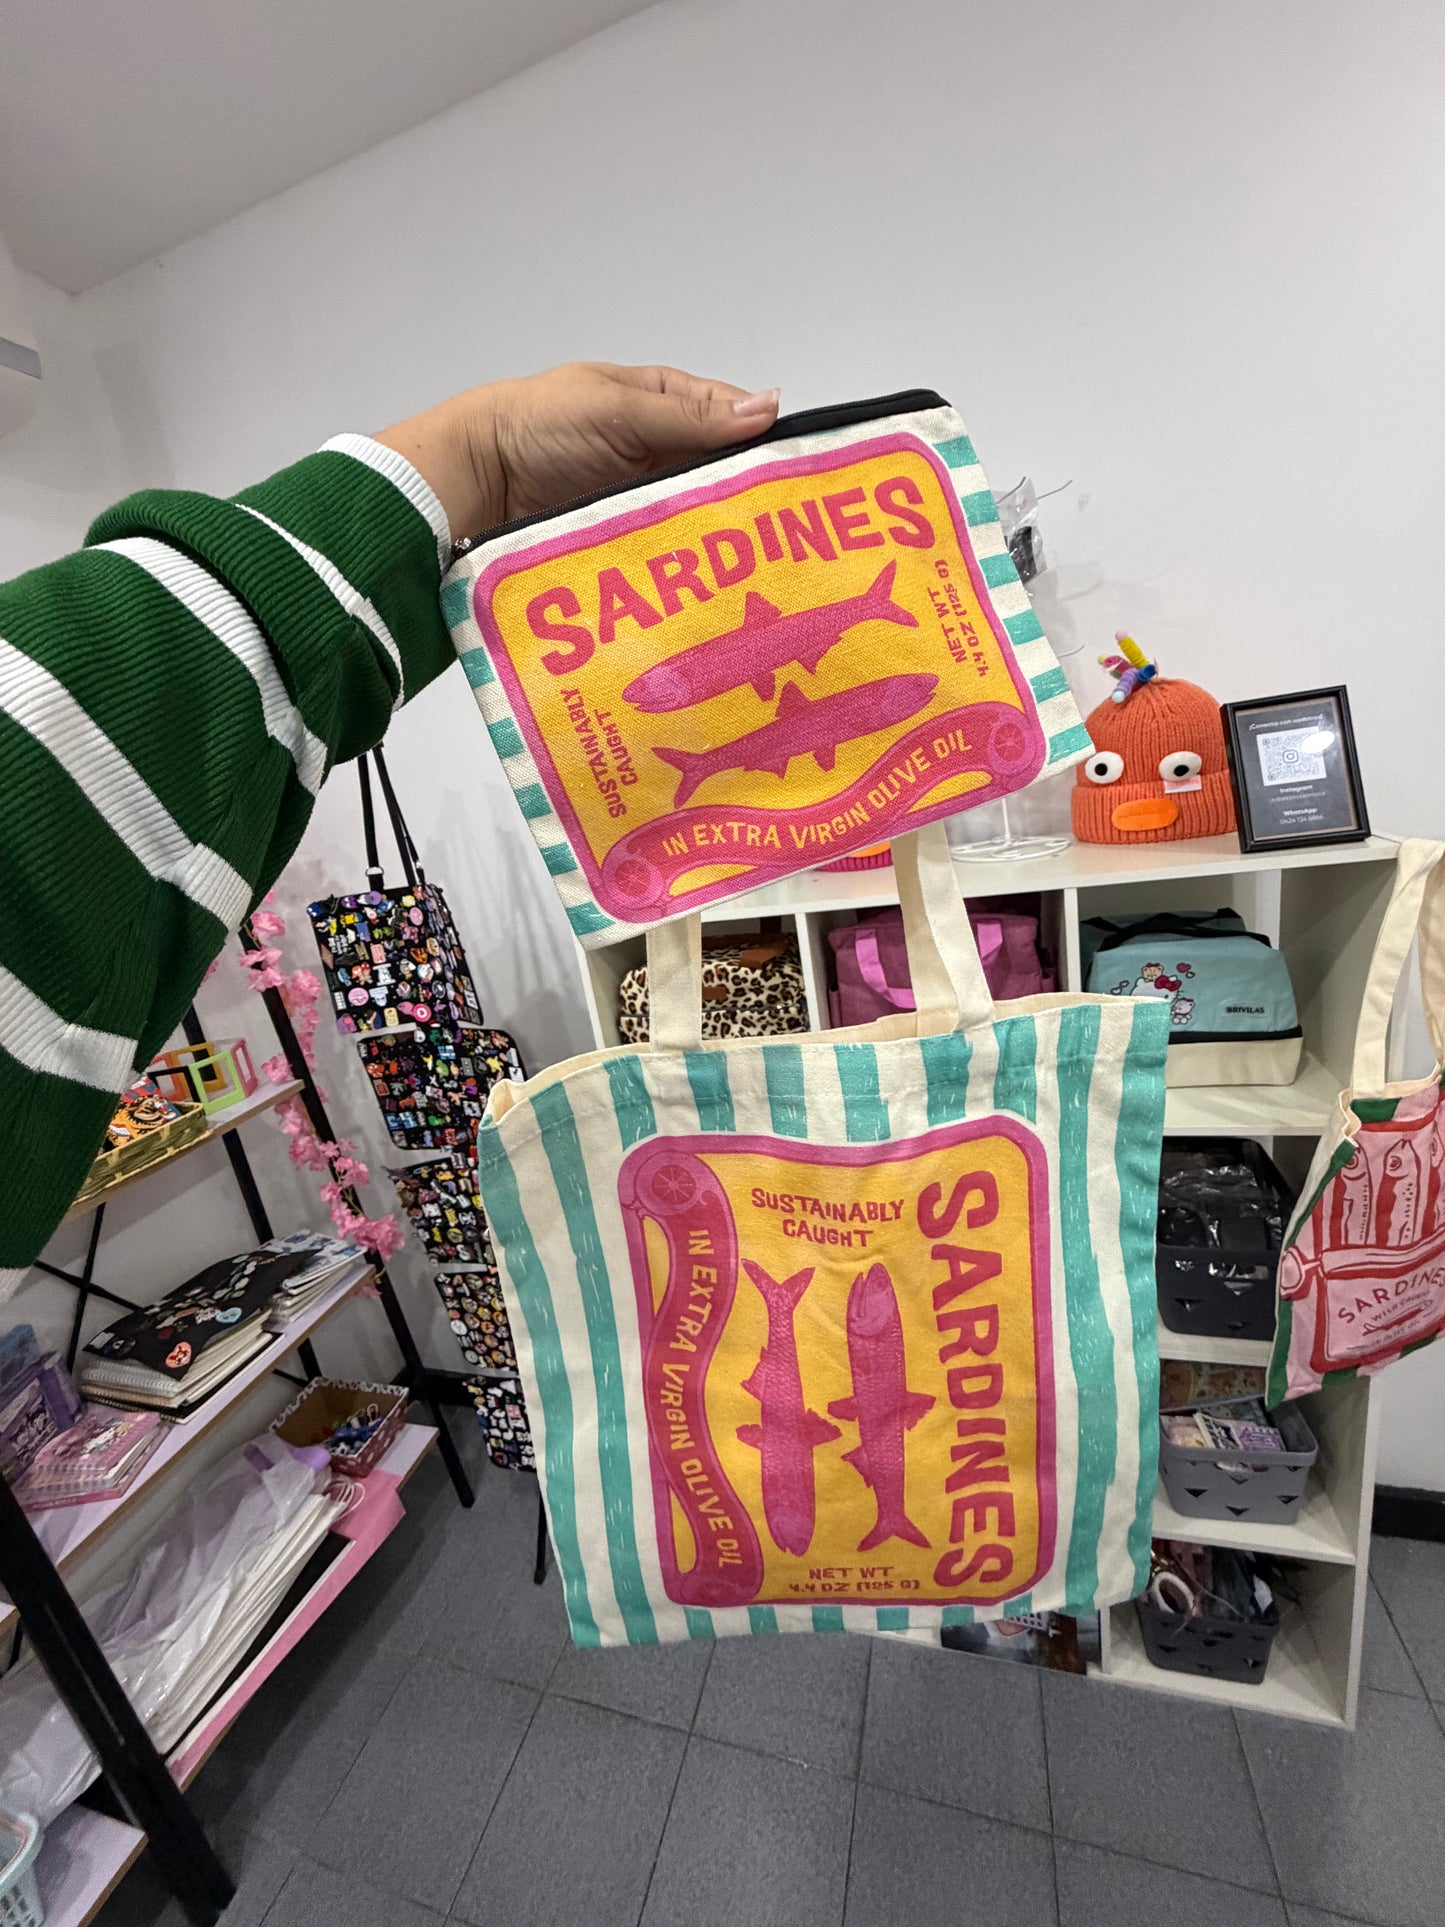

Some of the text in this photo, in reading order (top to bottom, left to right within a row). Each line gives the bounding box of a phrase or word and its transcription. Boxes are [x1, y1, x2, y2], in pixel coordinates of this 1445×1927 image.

[525, 476, 936, 676] SARDINES
[927, 587, 967, 664] NET WT
[959, 621, 979, 648] OZ
[973, 651, 989, 678] 4.4
[560, 688, 627, 819] SUSTAINABLY
[594, 709, 638, 786] CAUGHT
[662, 728, 972, 856] IN EXTRA VIRGIN OLIVE OIL
[751, 1187, 905, 1223] SUSTAINABLY
[782, 1218, 874, 1247] CAUGHT
[660, 1229, 743, 1568] IN EXTRA VIRGIN OLIVE OIL
[916, 1170, 1016, 1588] SARDINES
[789, 1582, 816, 1593] 4.4
[821, 1582, 851, 1592] OZ
[809, 1566, 894, 1580] NET WT
